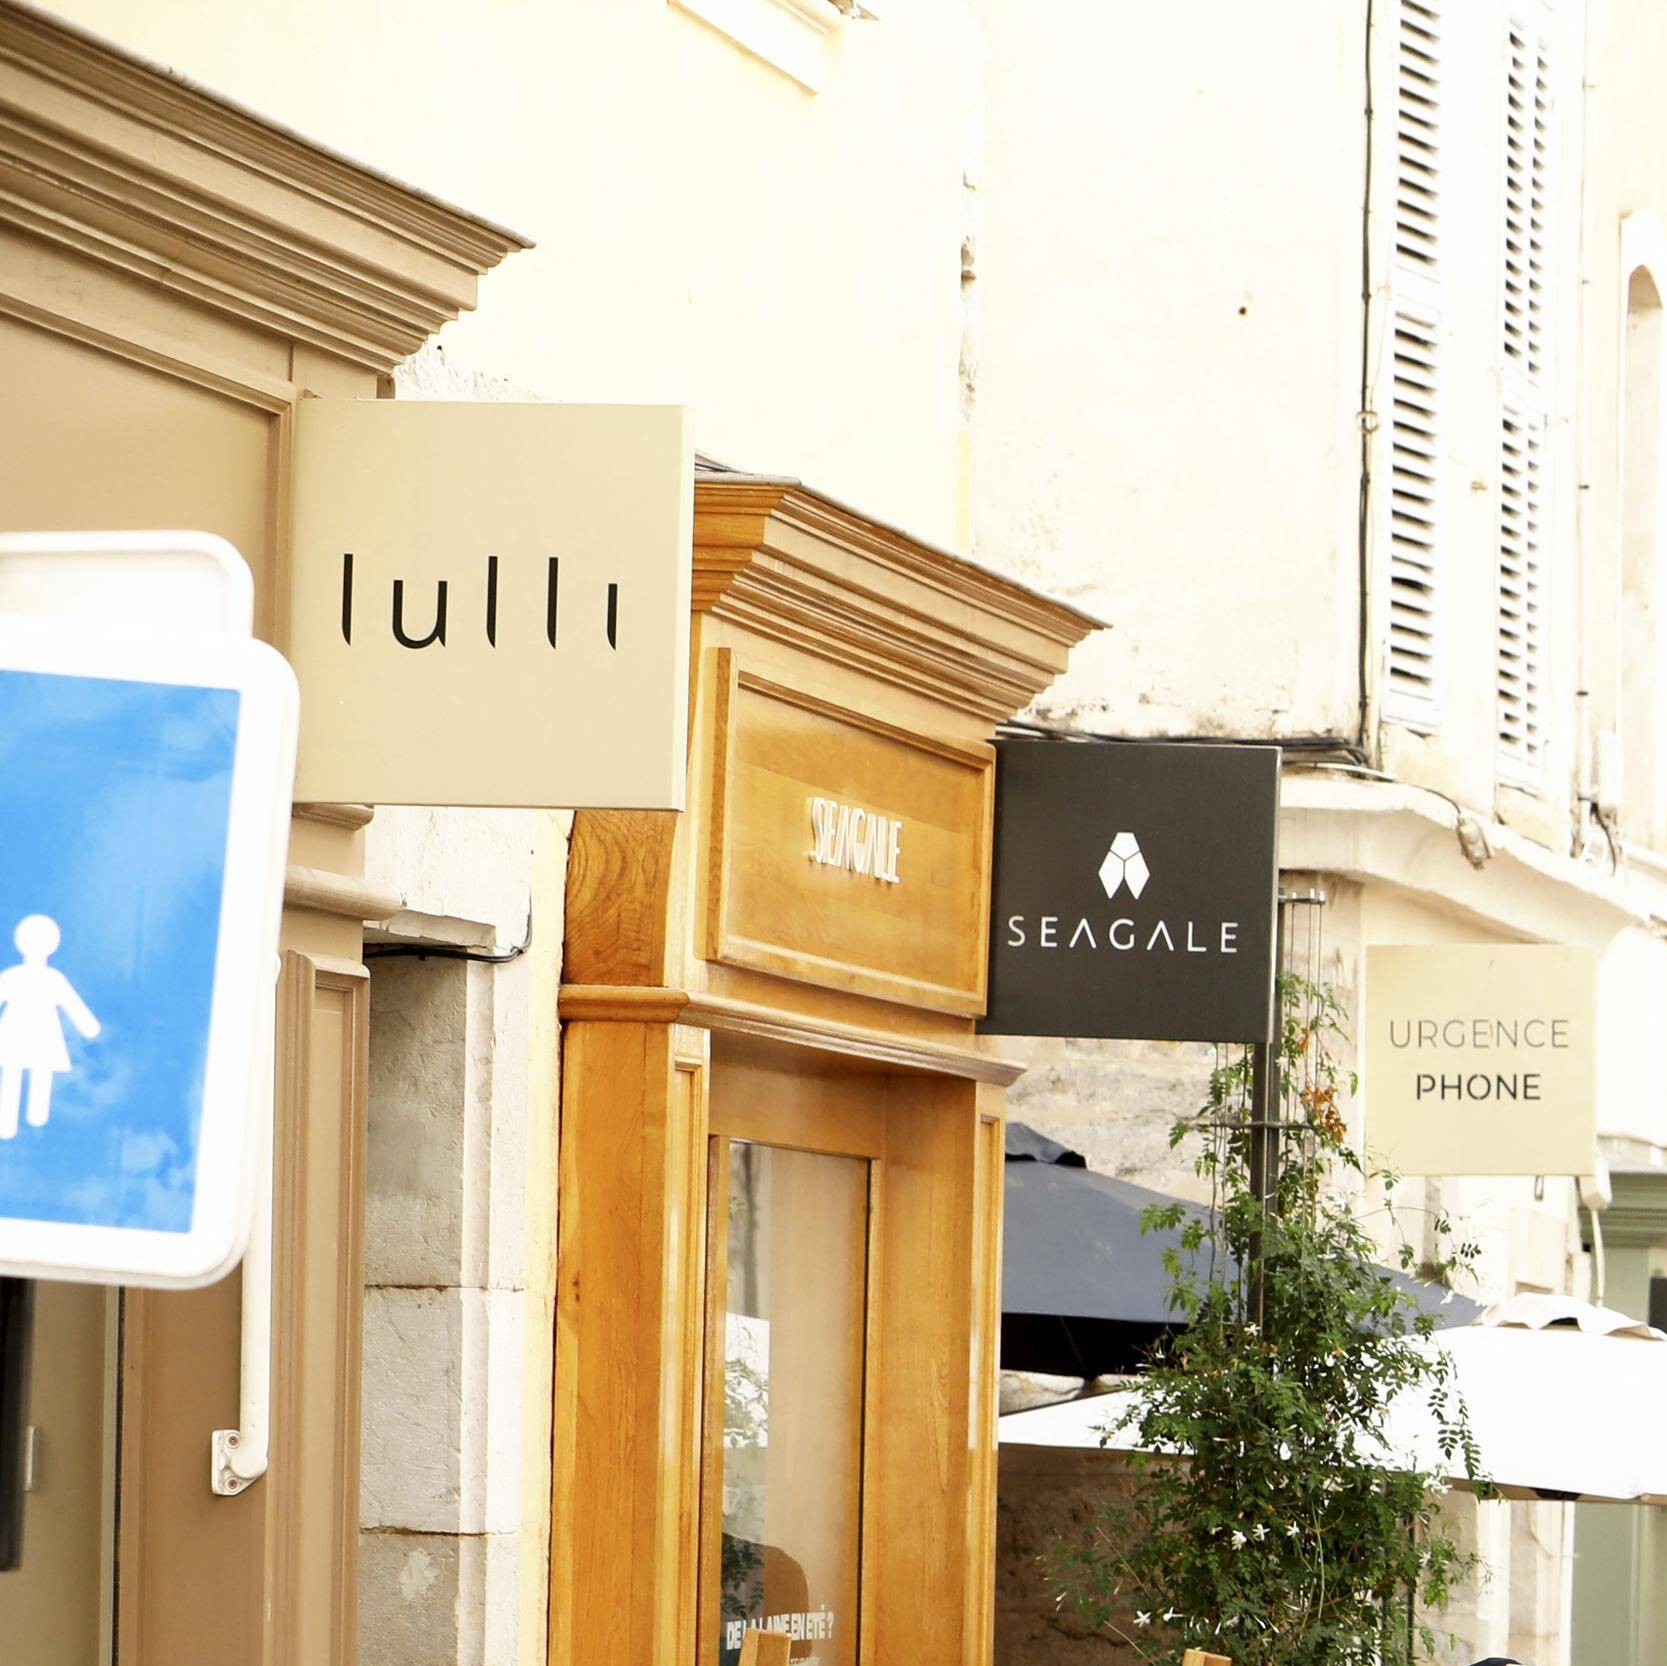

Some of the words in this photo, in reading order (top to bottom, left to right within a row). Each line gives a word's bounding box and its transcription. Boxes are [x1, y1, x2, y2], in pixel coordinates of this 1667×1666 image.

[342, 553, 618, 650] lulli
[1008, 915, 1238, 953] SEAGALE
[1390, 1019, 1569, 1049] URGENCE
[1416, 1073, 1541, 1101] PHONE
